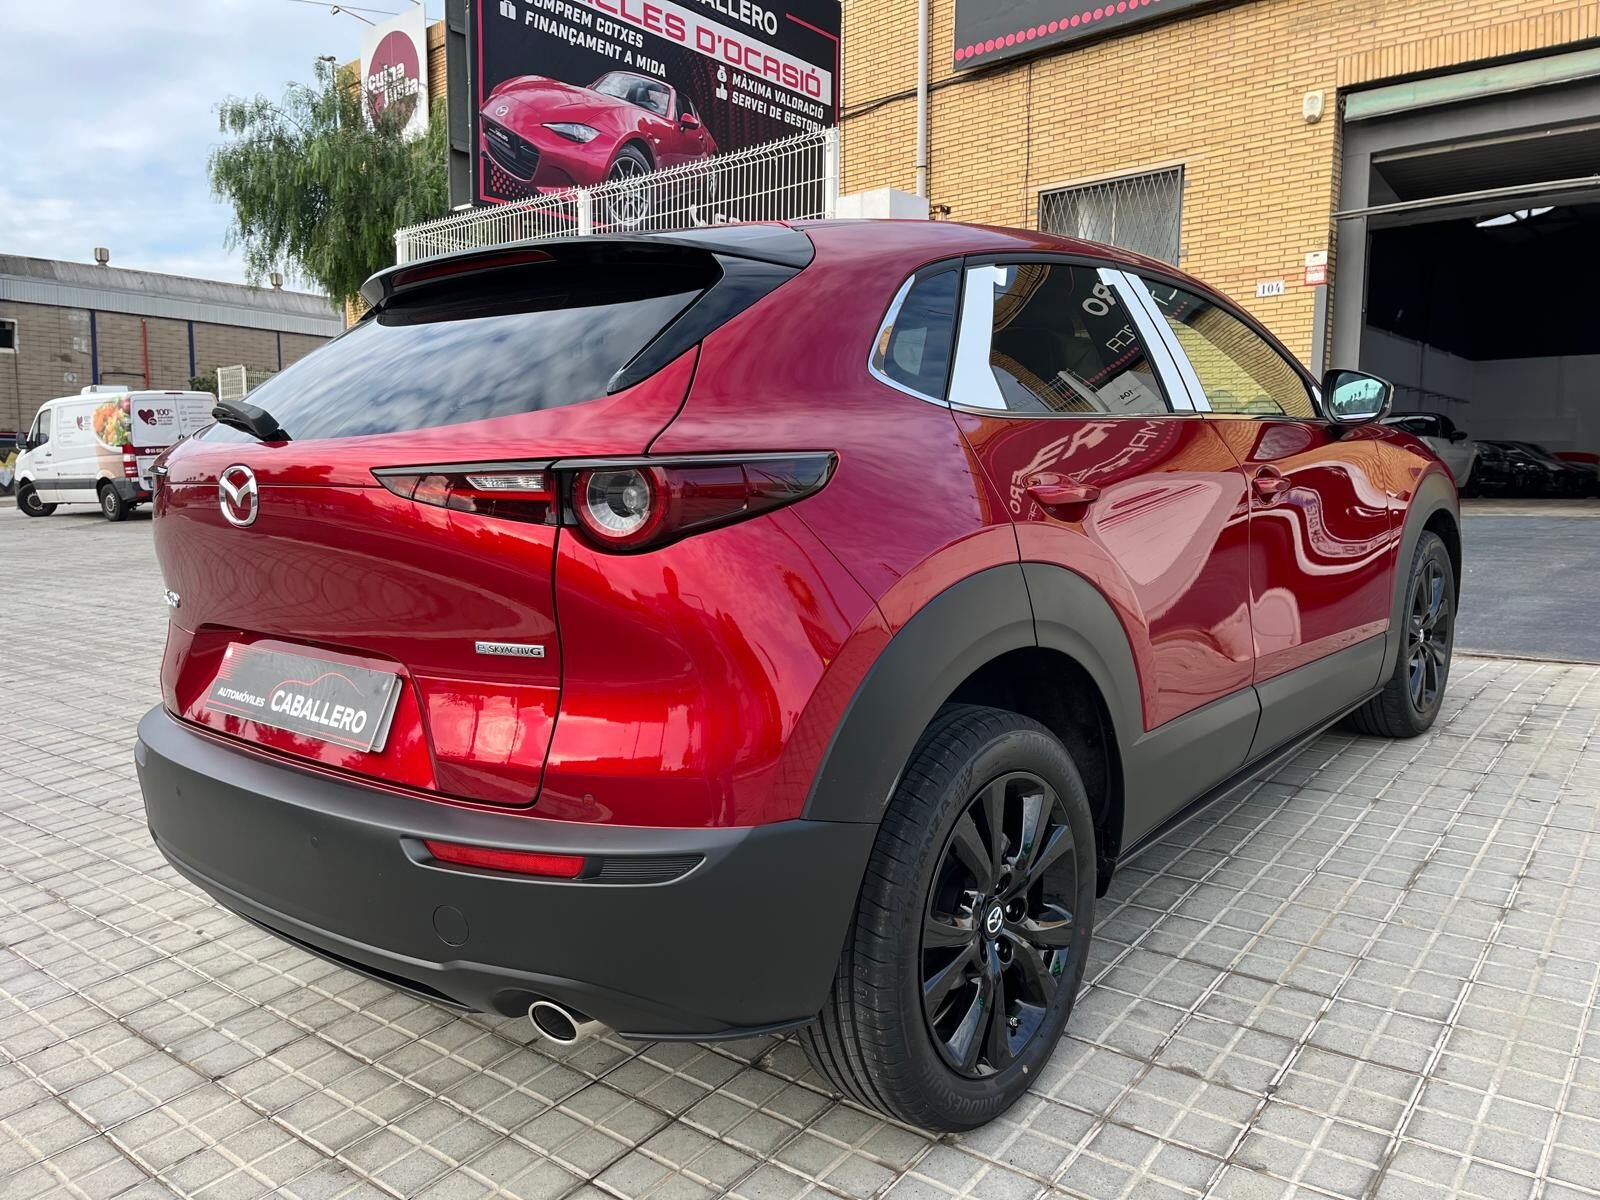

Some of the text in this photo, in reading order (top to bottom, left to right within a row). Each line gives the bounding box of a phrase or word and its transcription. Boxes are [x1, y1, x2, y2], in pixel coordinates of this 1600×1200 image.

[525, 10, 666, 78] FINANÇAMENT A MIDA
[596, 17, 644, 48] COTXES
[696, 25, 821, 98] D'OCASIÓ
[732, 72, 824, 120] MÀXIMA VALORACIÓ
[732, 91, 767, 115] SERVEI
[769, 105, 782, 121] DE
[1261, 283, 1281, 295] 104
[217, 687, 266, 708] AUTOMÓVILES
[270, 690, 367, 734] CABALLERO
